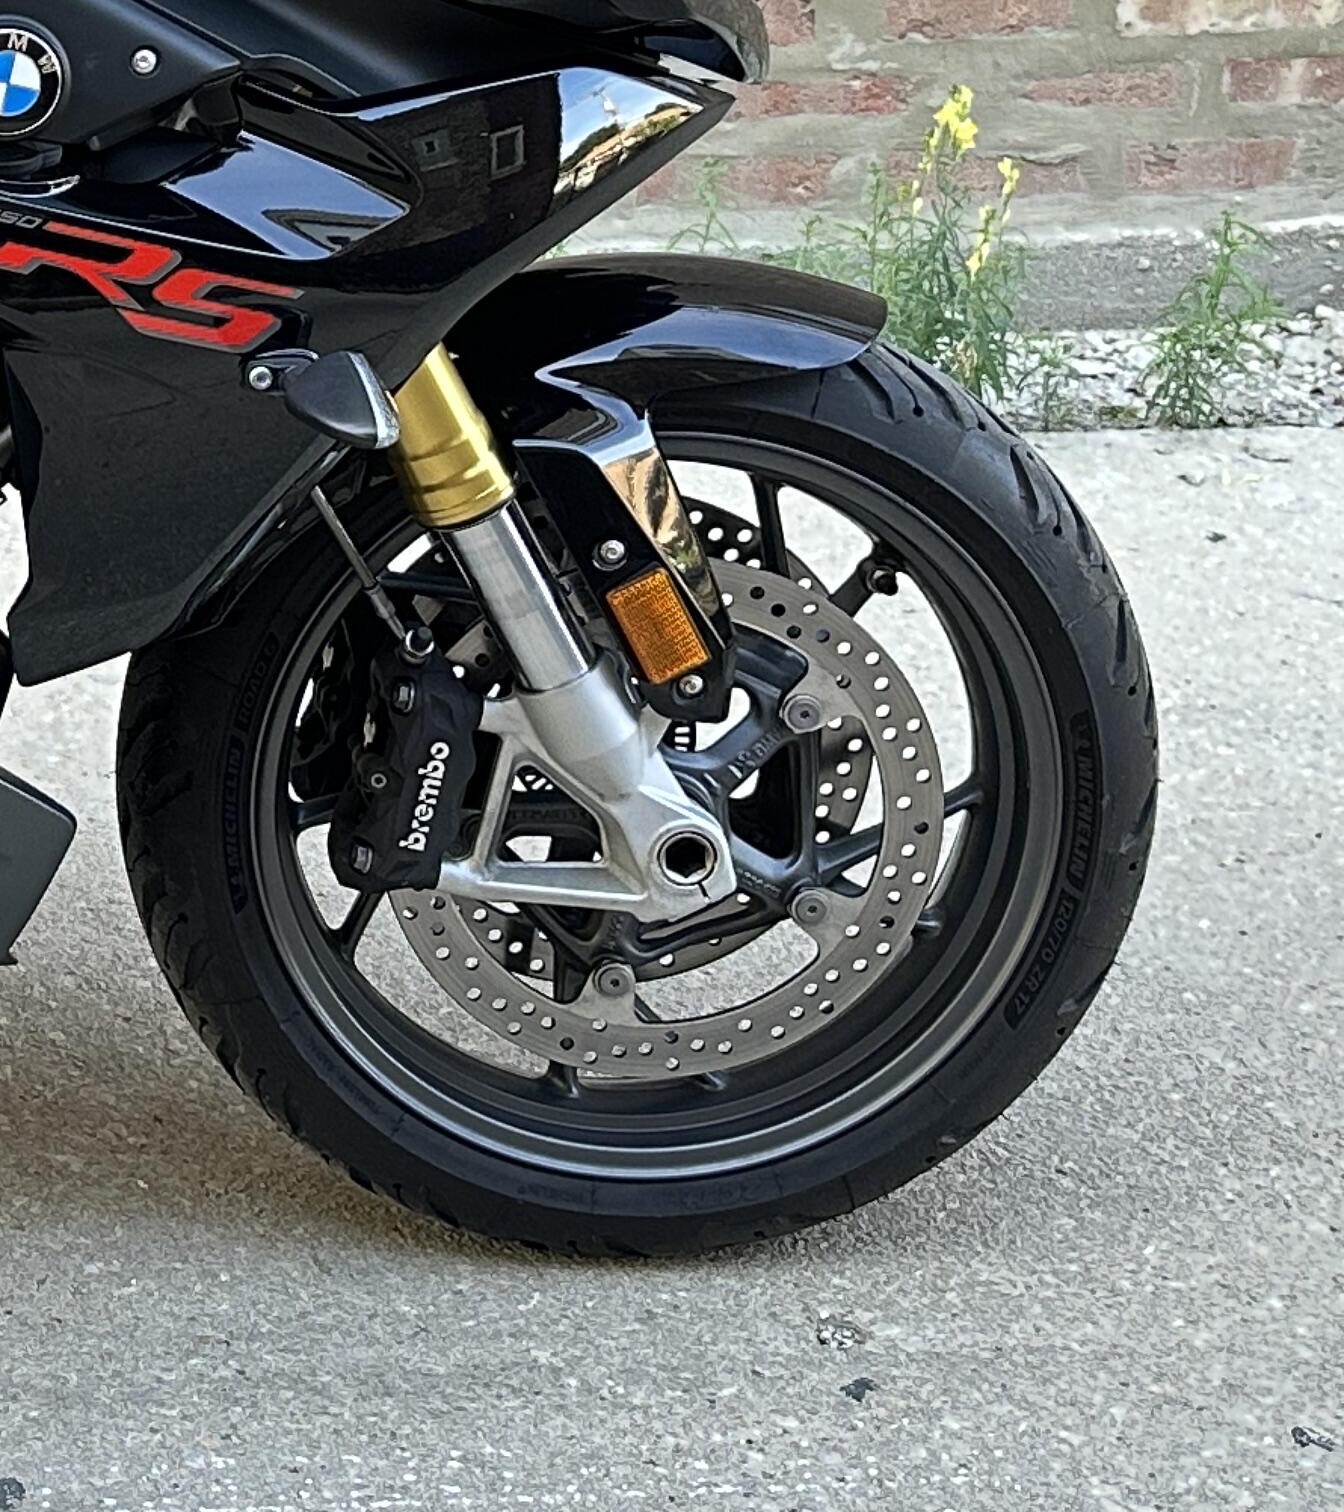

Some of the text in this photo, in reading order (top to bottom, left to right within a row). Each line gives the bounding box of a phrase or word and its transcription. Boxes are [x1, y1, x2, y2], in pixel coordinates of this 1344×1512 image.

[223, 748, 243, 867] MICHELIN
[238, 661, 267, 724] ROAD
[398, 741, 450, 851] brembo
[1013, 755, 1094, 1013] MICHELIN 120/70 ZR 17
